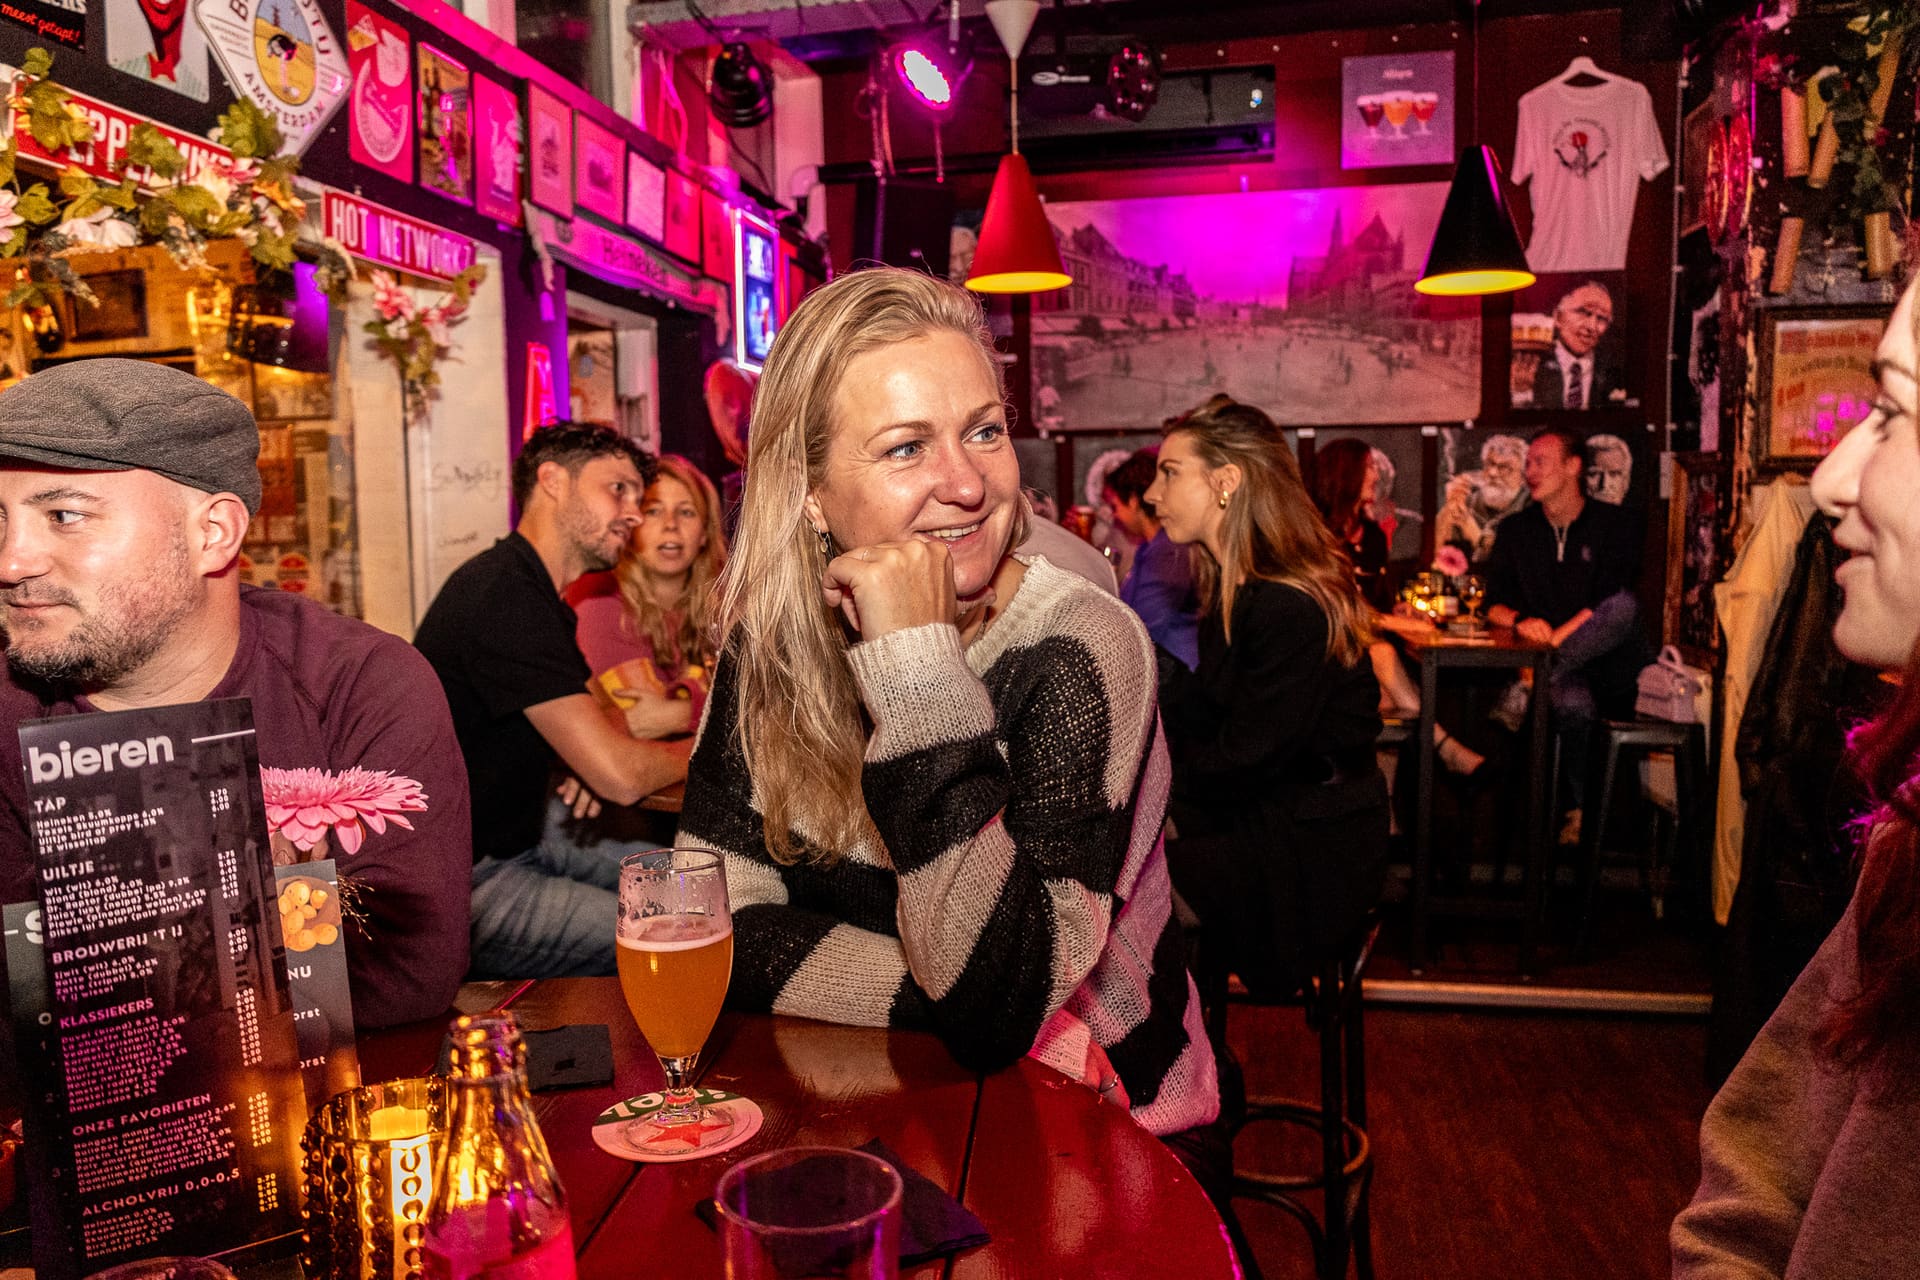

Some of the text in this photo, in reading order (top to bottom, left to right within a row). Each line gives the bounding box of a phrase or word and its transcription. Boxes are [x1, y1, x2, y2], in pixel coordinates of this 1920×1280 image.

[1, 3, 38, 25] meest
[331, 197, 369, 252] HOT
[28, 734, 174, 784] bieren
[34, 796, 66, 814] TAP
[36, 812, 85, 829] Heineken
[75, 811, 139, 831] Skuumkoppe
[38, 833, 67, 846] Uiltje
[70, 828, 92, 840] bird
[94, 826, 105, 835] of
[108, 821, 131, 833] prey
[56, 835, 106, 852] wisseltap
[42, 860, 94, 882] UILTJE
[44, 886, 62, 896] Wit
[65, 880, 91, 893] (wit)
[45, 891, 75, 905] Blond
[78, 883, 117, 899] (blond)
[103, 885, 142, 902] (dubbel
[145, 881, 165, 893] ipa)
[81, 921, 95, 931] lul
[107, 914, 127, 925] bier
[131, 907, 157, 920] (pale
[160, 902, 179, 914] ale)
[52, 924, 182, 964] BROUWERIJ 'T IJ
[55, 974, 84, 987] Natte
[88, 963, 132, 981] (dubbel)
[82, 960, 108, 973] (wit)
[88, 973, 126, 989] (tripel)
[60, 997, 153, 1029] KLASSIEKERS
[68, 1083, 103, 1098] Amstel
[69, 1091, 104, 1105] Amstel
[72, 1092, 210, 1137] ONZE FAVORIETEN
[82, 1167, 239, 1217] ALCHOLVRIJ 0,0-0,5
